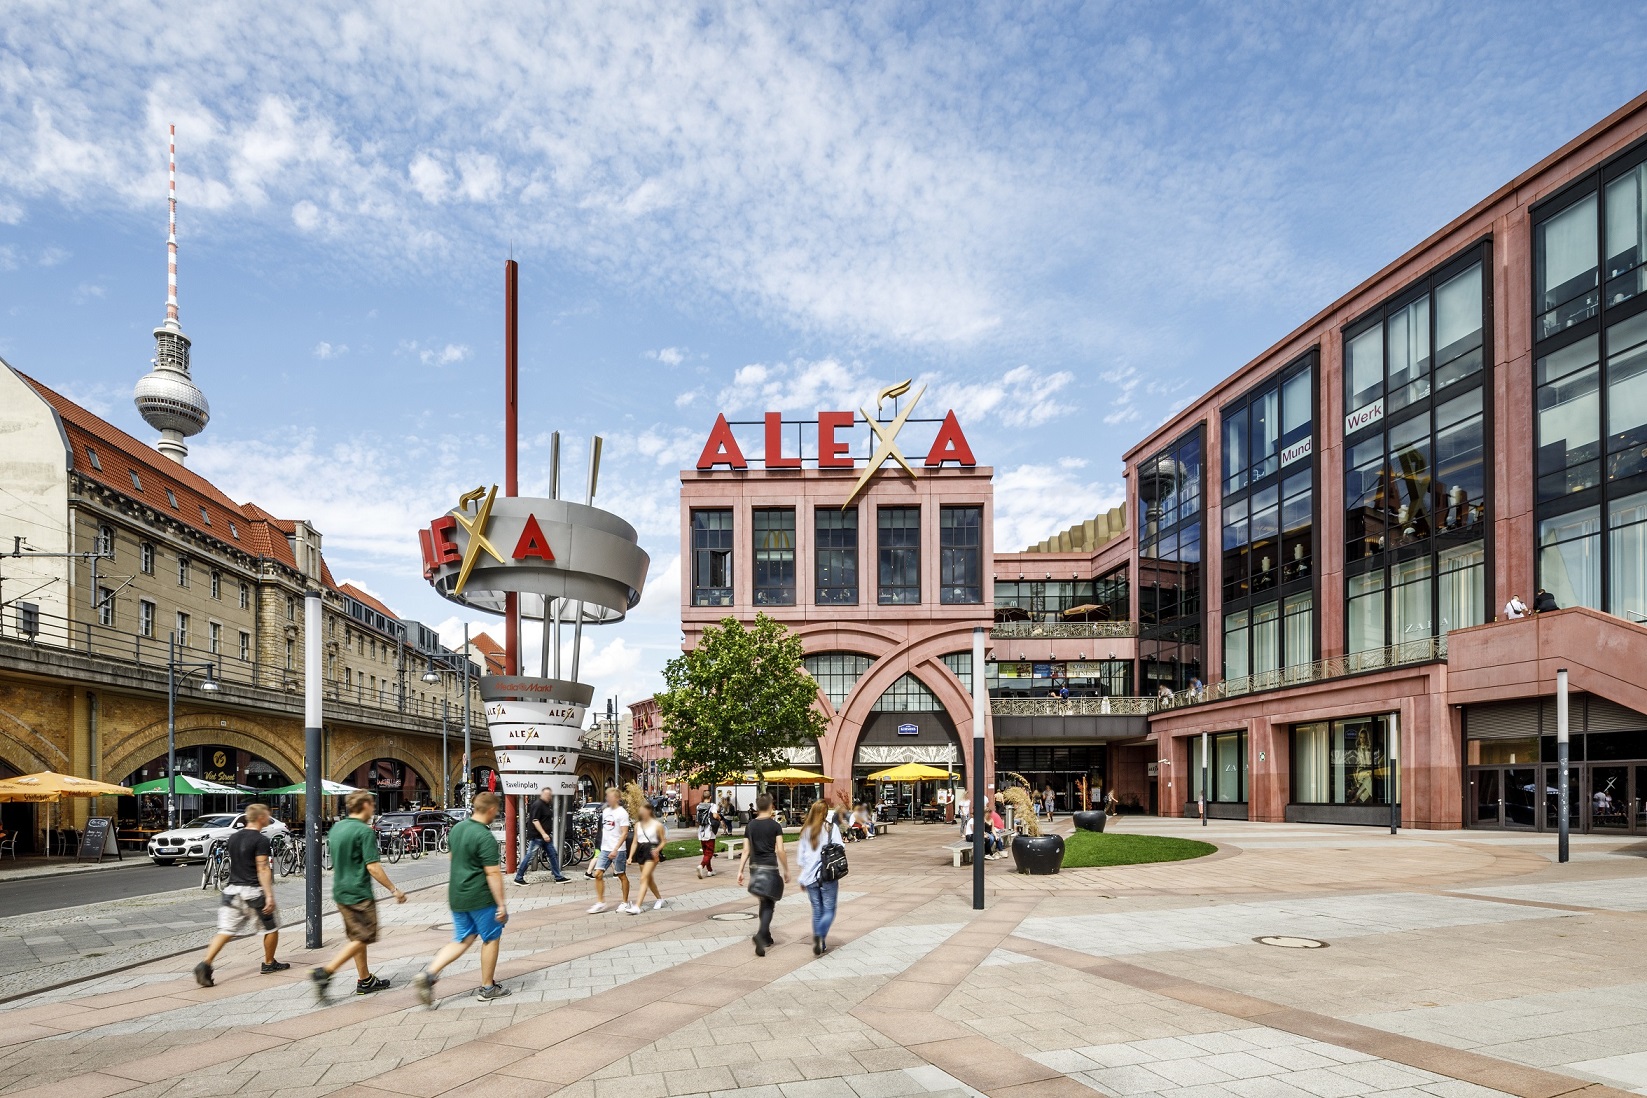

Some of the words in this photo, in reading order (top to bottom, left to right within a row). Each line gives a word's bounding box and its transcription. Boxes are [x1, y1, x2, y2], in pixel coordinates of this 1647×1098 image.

[1347, 404, 1382, 430] Werk
[696, 378, 977, 511] ALEXA
[1282, 438, 1311, 463] Mund
[549, 707, 575, 723] ALEXA
[509, 726, 540, 744] ALEXA
[538, 754, 567, 770] ALEXA
[218, 771, 235, 781] Street
